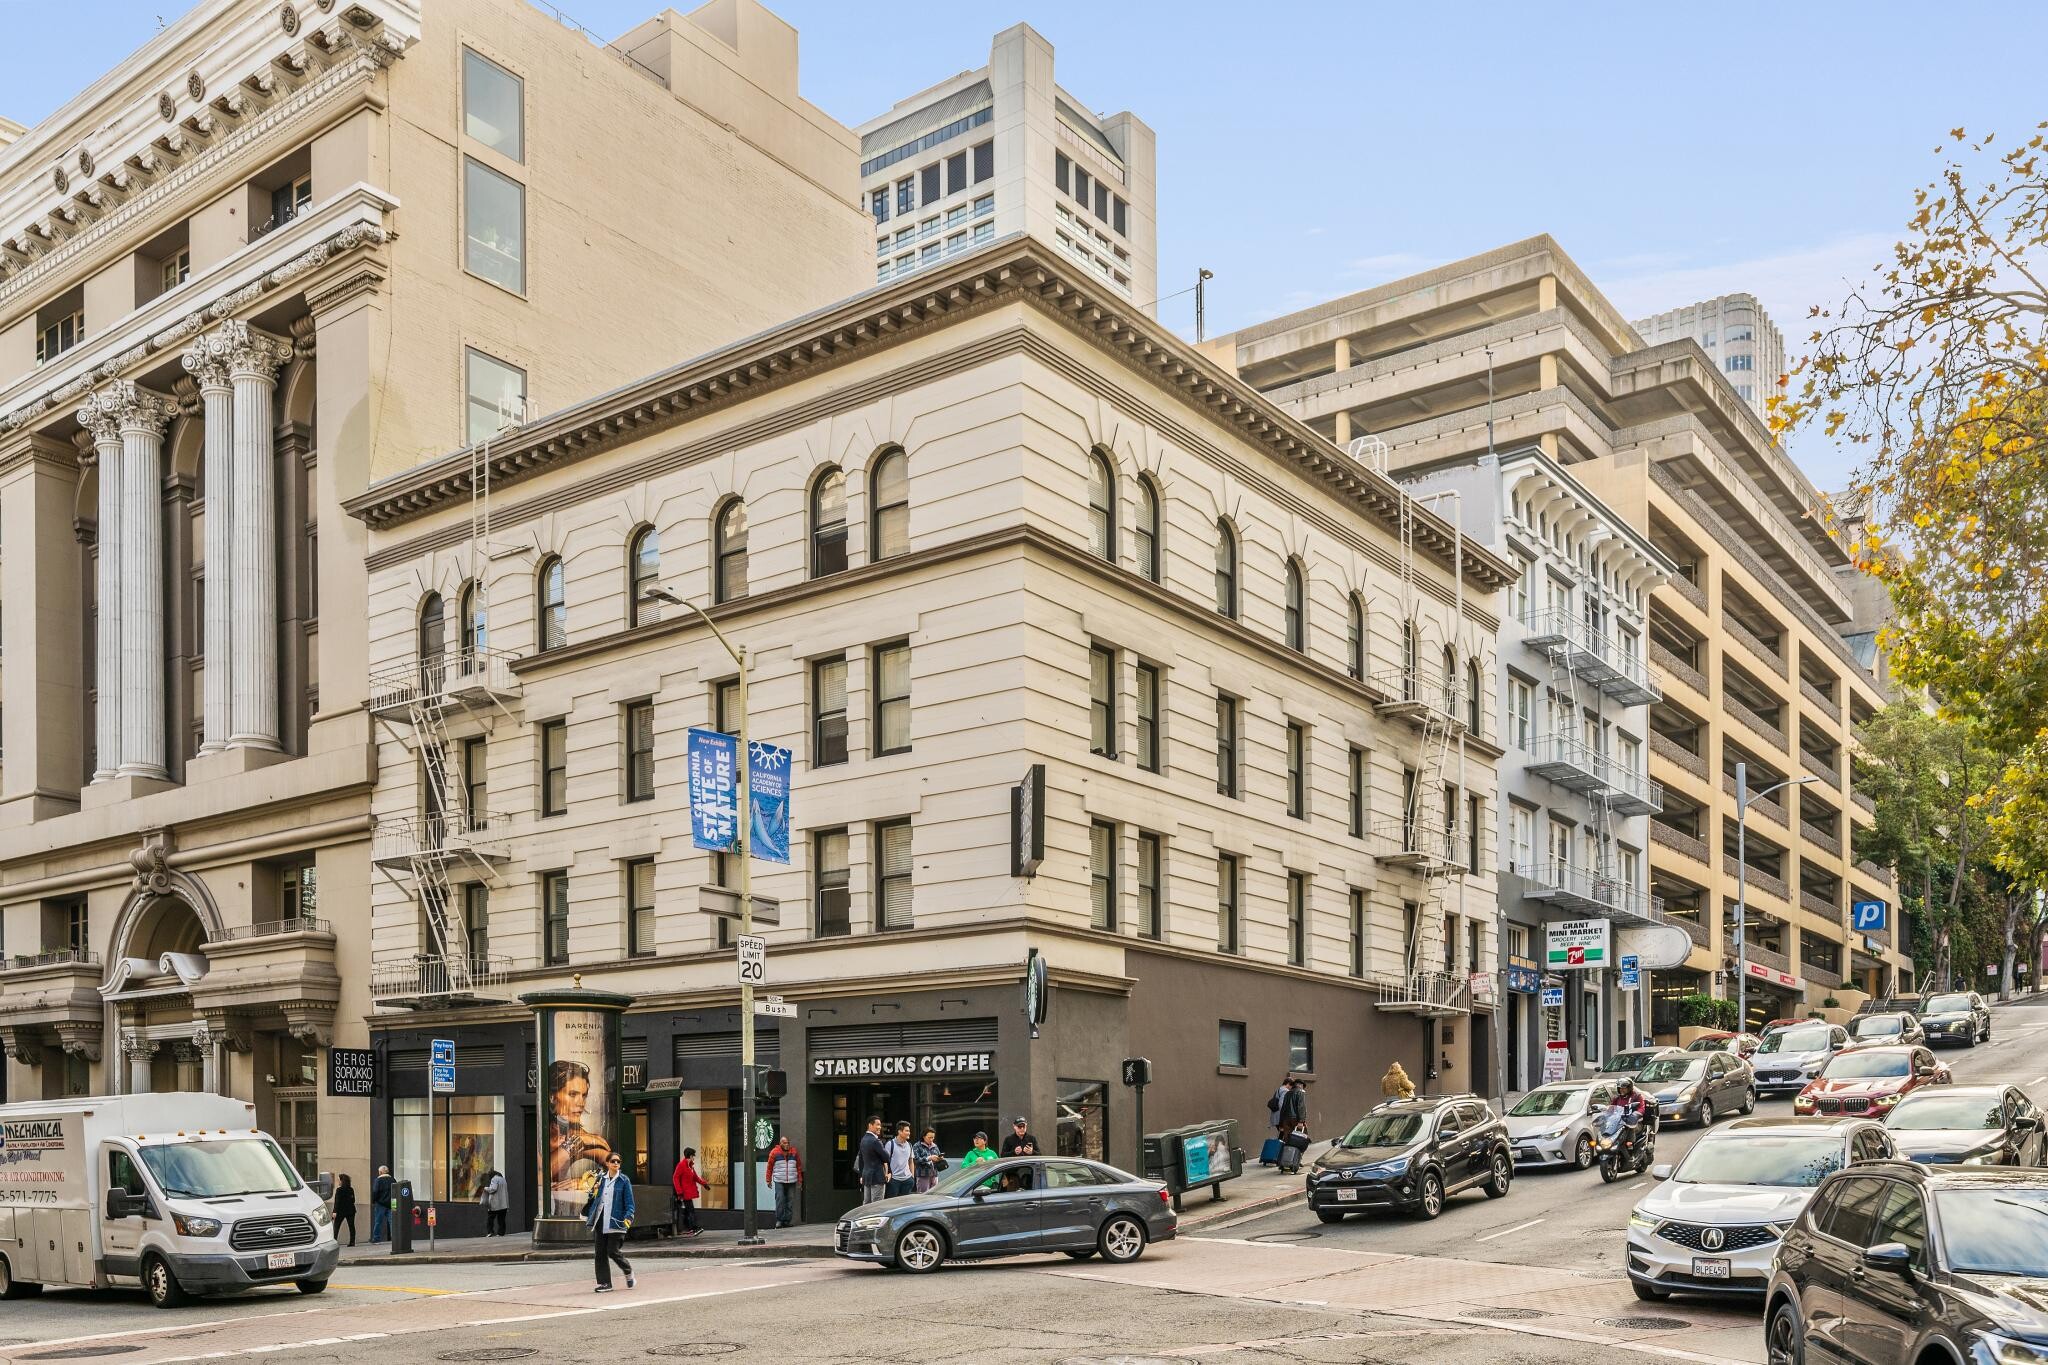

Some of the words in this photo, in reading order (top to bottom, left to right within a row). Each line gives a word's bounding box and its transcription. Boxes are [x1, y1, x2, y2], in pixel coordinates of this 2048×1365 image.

[698, 737, 709, 745] New
[710, 739, 727, 748] Exhibit
[703, 758, 713, 774] OF
[752, 771, 782, 783] CALIFORNIA
[752, 777, 777, 788] ACADEMY
[691, 750, 702, 818] CALIFORNIA
[715, 749, 733, 836] NATURE
[751, 784, 782, 797] SCIENCES
[701, 776, 718, 841] STATE
[1569, 927, 1603, 935] MARKET
[740, 940, 763, 951] SPEED
[742, 950, 761, 960] LIMIT
[741, 960, 763, 980] 20
[1543, 997, 1562, 1005] ATM
[765, 1004, 787, 1013] Bush
[335, 1052, 374, 1067] SERGE
[814, 1056, 917, 1076] STARBUCKS
[920, 1054, 990, 1073] COFFEE
[335, 1066, 374, 1080] SOROKKO
[335, 1080, 374, 1093] GALLERY
[650, 1080, 681, 1089] NEWSSTAND
[5, 1122, 63, 1139] MECHANICAL
[20, 1172, 64, 1182] CONDITIONING
[1695, 1265, 1727, 1276] 8LPE450
